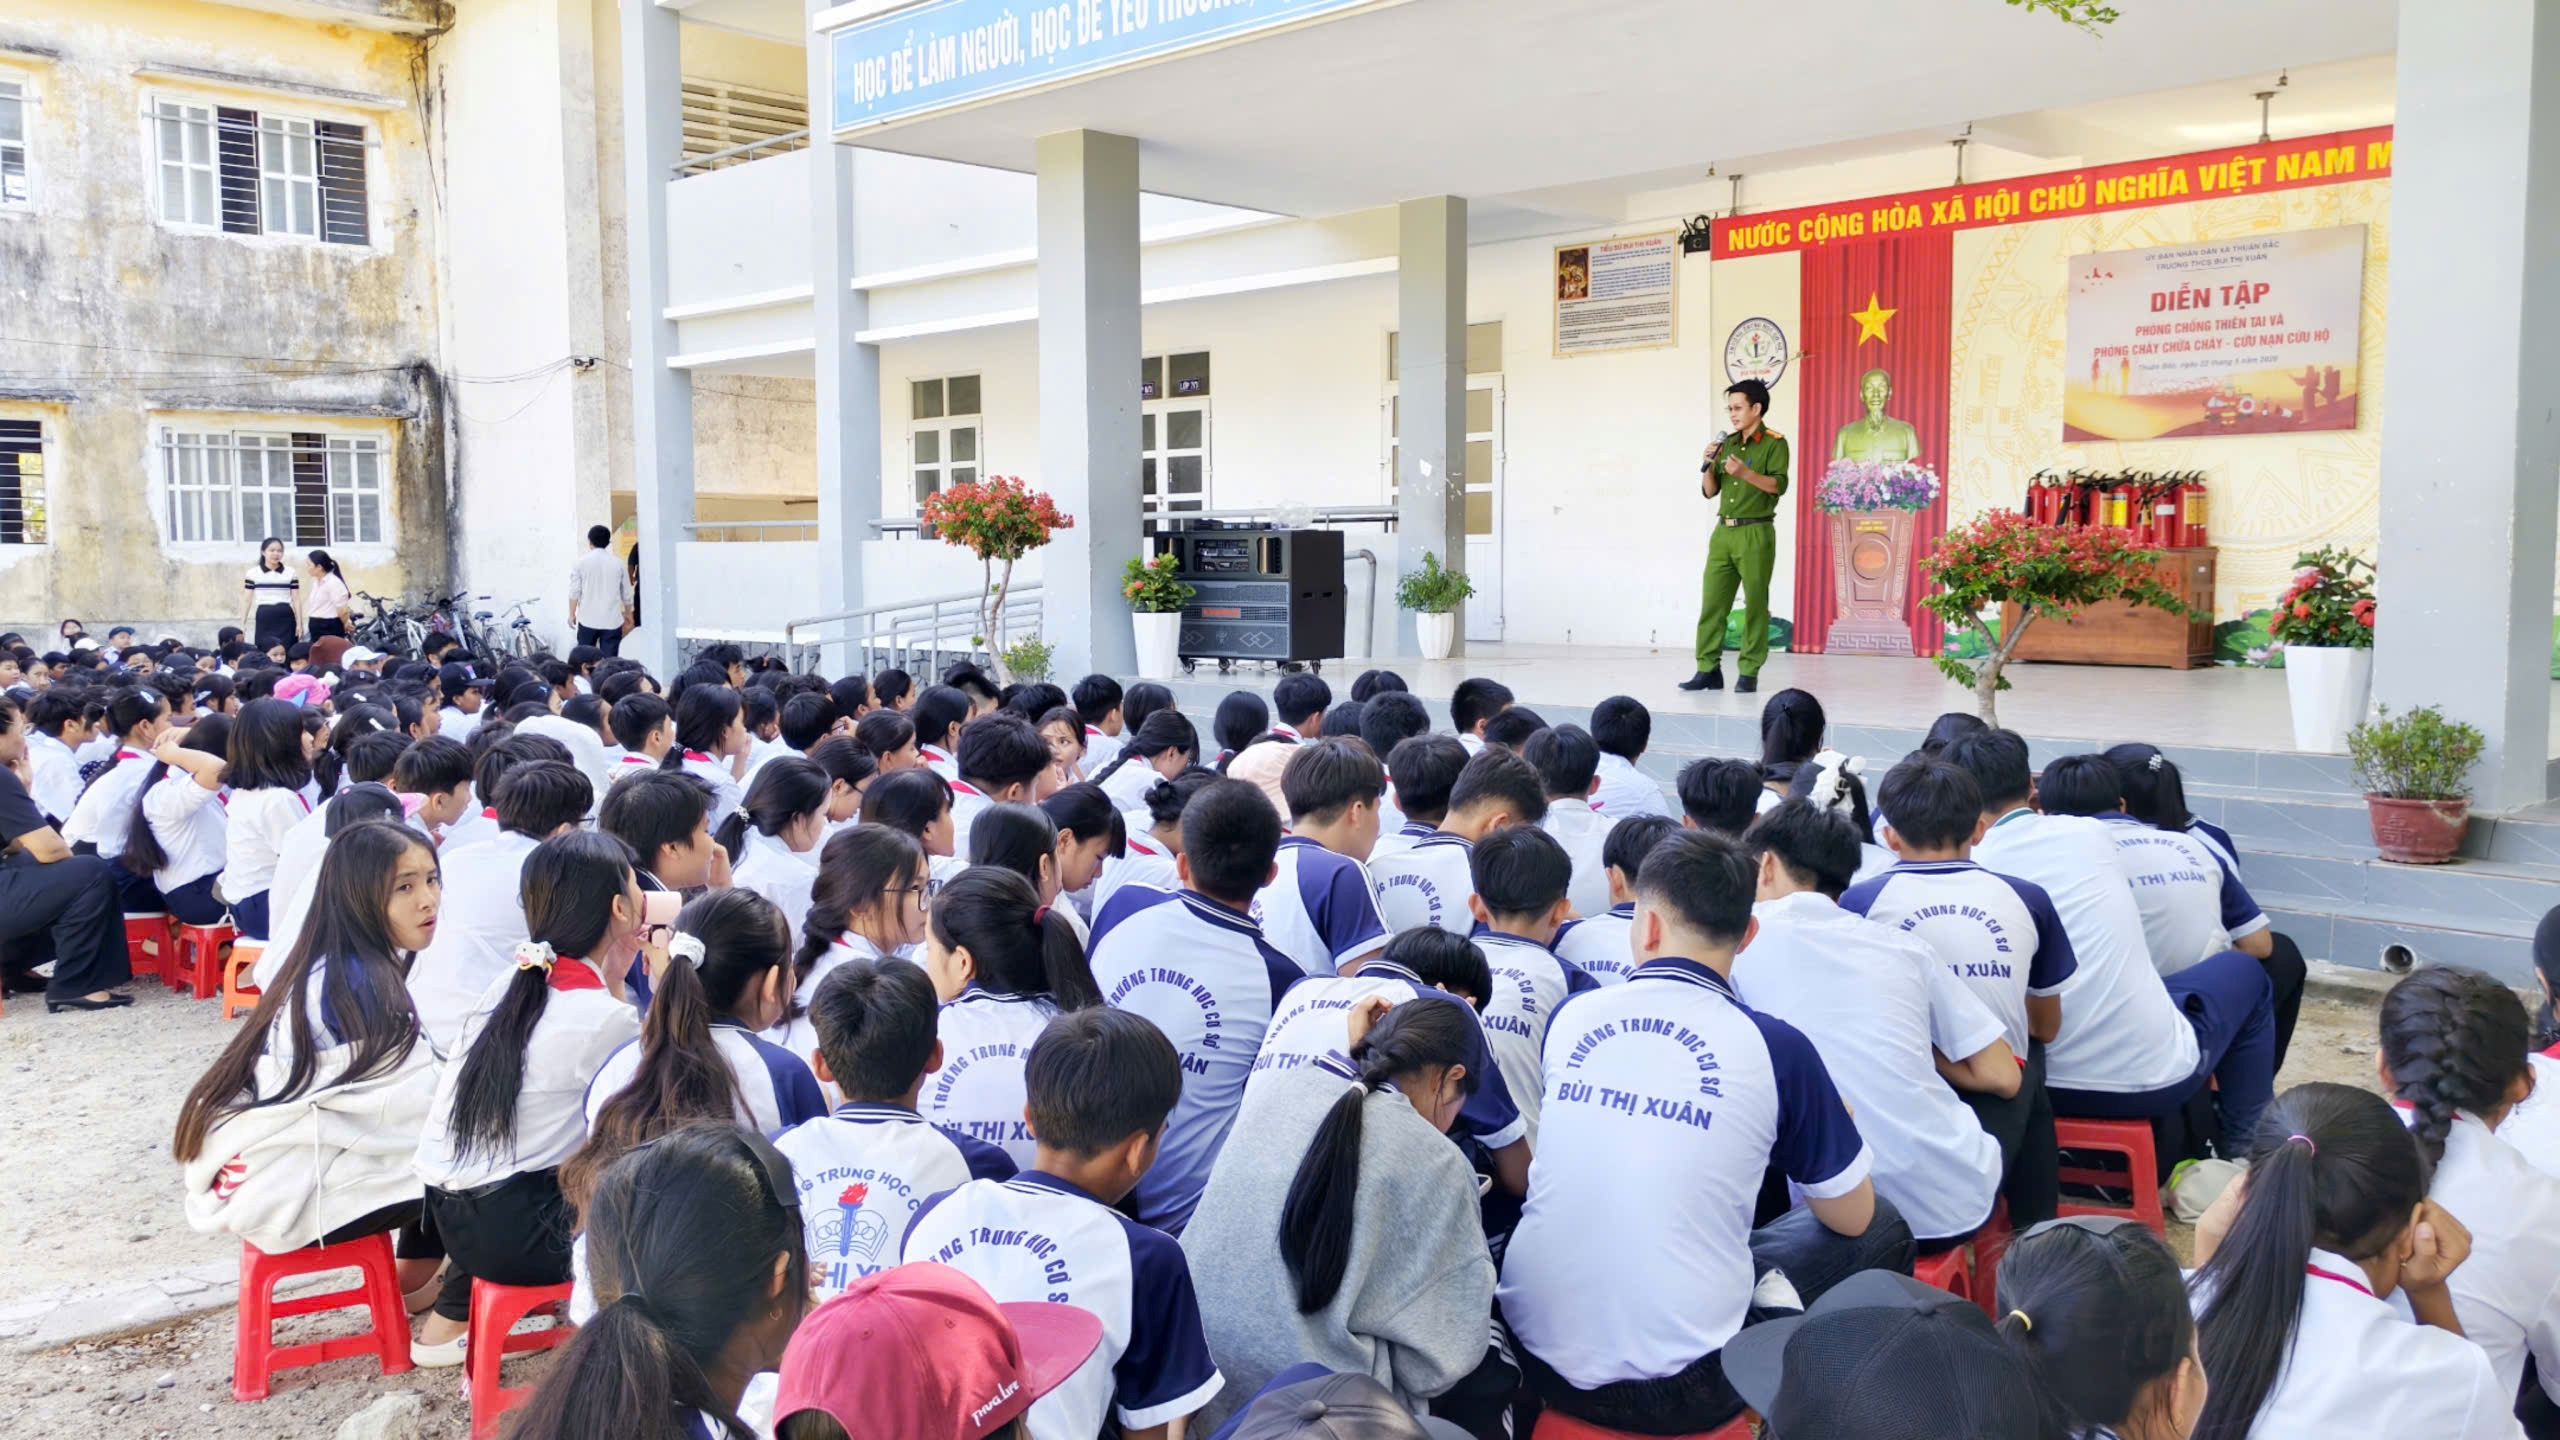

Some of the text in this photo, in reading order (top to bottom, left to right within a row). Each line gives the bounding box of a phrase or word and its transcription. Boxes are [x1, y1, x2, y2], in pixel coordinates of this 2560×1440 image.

[853, 55, 886, 110] HỌC
[890, 29, 914, 94] ĐỂ
[918, 32, 957, 87] LÀM
[961, 8, 1025, 76] NGƯỜI,
[1031, 3, 1072, 64] HỌC
[1728, 219, 1792, 252] NƯỚC
[1798, 212, 1864, 245] CỘNG
[1872, 201, 1923, 233] HÒA
[1930, 194, 1966, 226] XÃ
[1974, 188, 2020, 223] HỘI
[2029, 175, 2087, 214] CHỦ
[2095, 166, 2189, 206] NGHĨA
[2198, 155, 2267, 193] VIỆT
[2276, 146, 2356, 182] NAM
[2150, 280, 2271, 313] DIỄN TẬP
[2215, 314, 2247, 331] THIÊN
[2250, 315, 2267, 328] TAI
[1389, 874, 1420, 888] TRUNG
[1914, 904, 1957, 920] TRUNG
[1961, 905, 1987, 921] HỌC
[1985, 918, 2005, 934] CƠ
[1581, 960, 1621, 973] TRUNG
[1965, 959, 2012, 978] XUÂN
[1150, 967, 1195, 991] TRUNG
[1190, 984, 1216, 1010] HỌC
[1522, 997, 1538, 1014] SỞ
[1205, 1012, 1222, 1028] CƠ
[1484, 1015, 1531, 1039] XUÂN
[1620, 1017, 1675, 1036] TRUNG
[969, 1043, 1016, 1061] TRUNG
[1202, 1033, 1221, 1050] SỞ
[1566, 1023, 1616, 1069] TRƯỜNG
[1696, 1052, 1721, 1071] CƠ
[1699, 1076, 1724, 1098] SỞ
[1557, 1079, 1713, 1131] BÙI THỊ XUÂN
[969, 1121, 1006, 1146] THỊ
[816, 1167, 876, 1183] TRUNG
[878, 1171, 912, 1197] HỌC
[970, 1227, 1029, 1246] TRUNG
[1024, 1234, 1057, 1260] HỌC
[1044, 1259, 1072, 1284] CƠ
